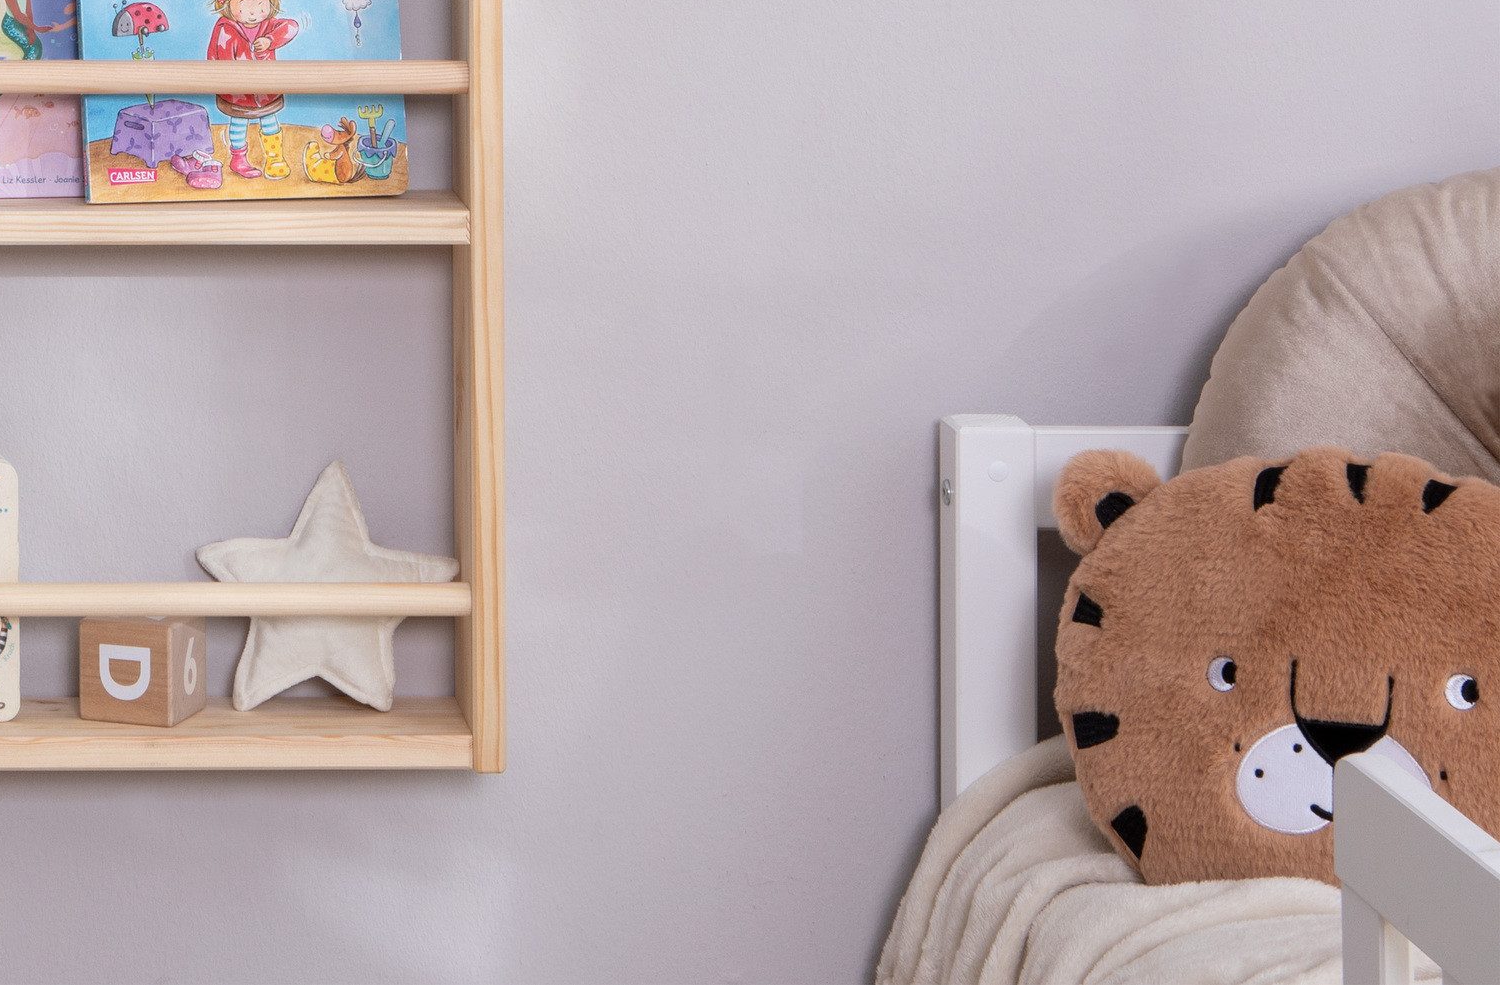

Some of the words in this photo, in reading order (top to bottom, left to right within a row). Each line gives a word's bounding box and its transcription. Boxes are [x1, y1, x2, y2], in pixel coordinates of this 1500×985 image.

[2, 175, 13, 184] Liz
[15, 175, 47, 184] Kessler
[110, 169, 156, 183] CARLSEN
[99, 643, 151, 701] D
[183, 636, 198, 696] 6
